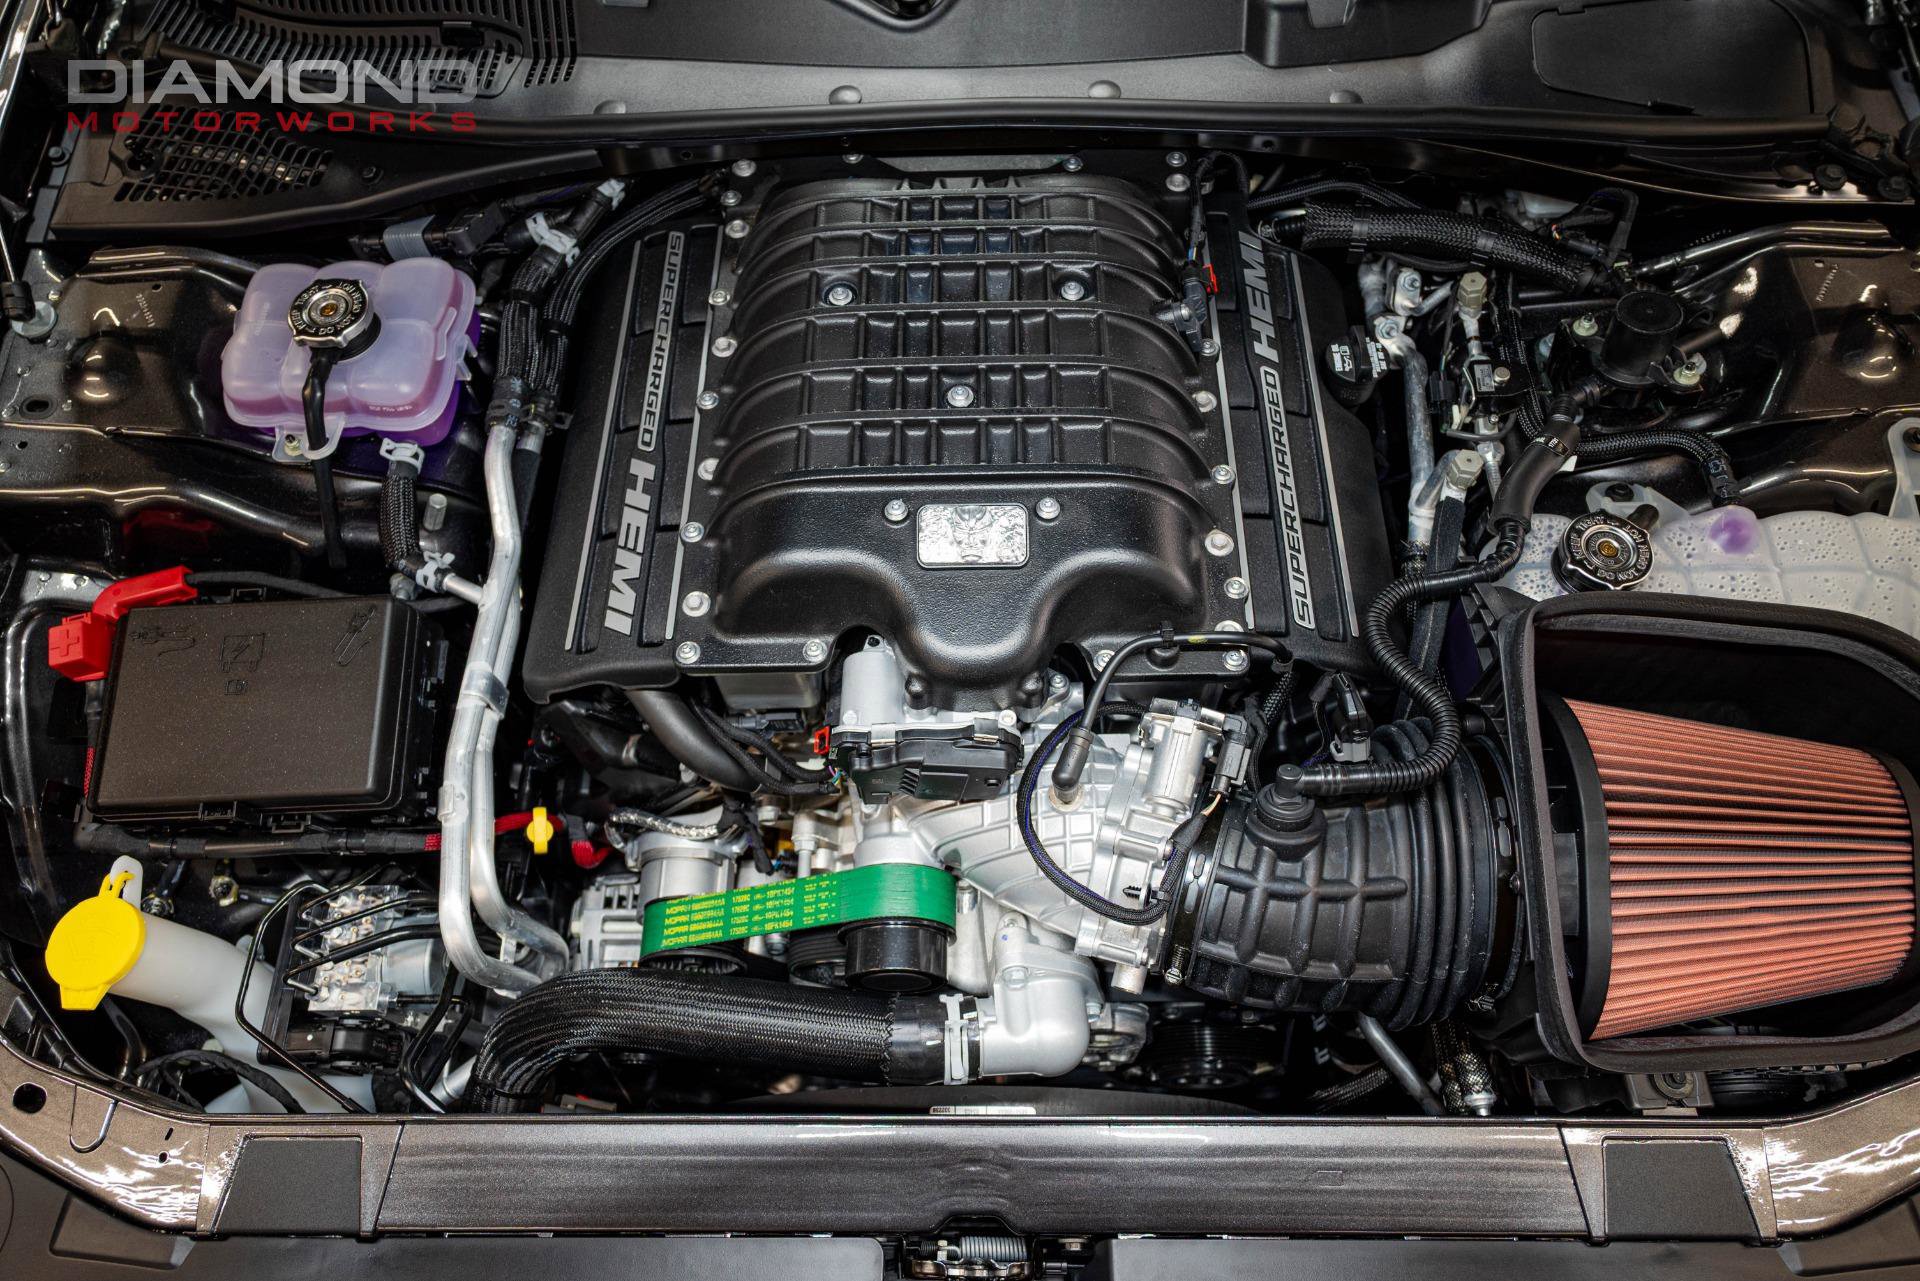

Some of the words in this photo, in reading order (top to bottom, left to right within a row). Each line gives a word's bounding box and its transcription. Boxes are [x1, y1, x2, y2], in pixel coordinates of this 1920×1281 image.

[639, 234, 683, 448] SUPERCHARGED
[1238, 231, 1279, 364] HEMI
[604, 458, 656, 636] HEMI
[1261, 368, 1312, 627] SUPERCHARGED
